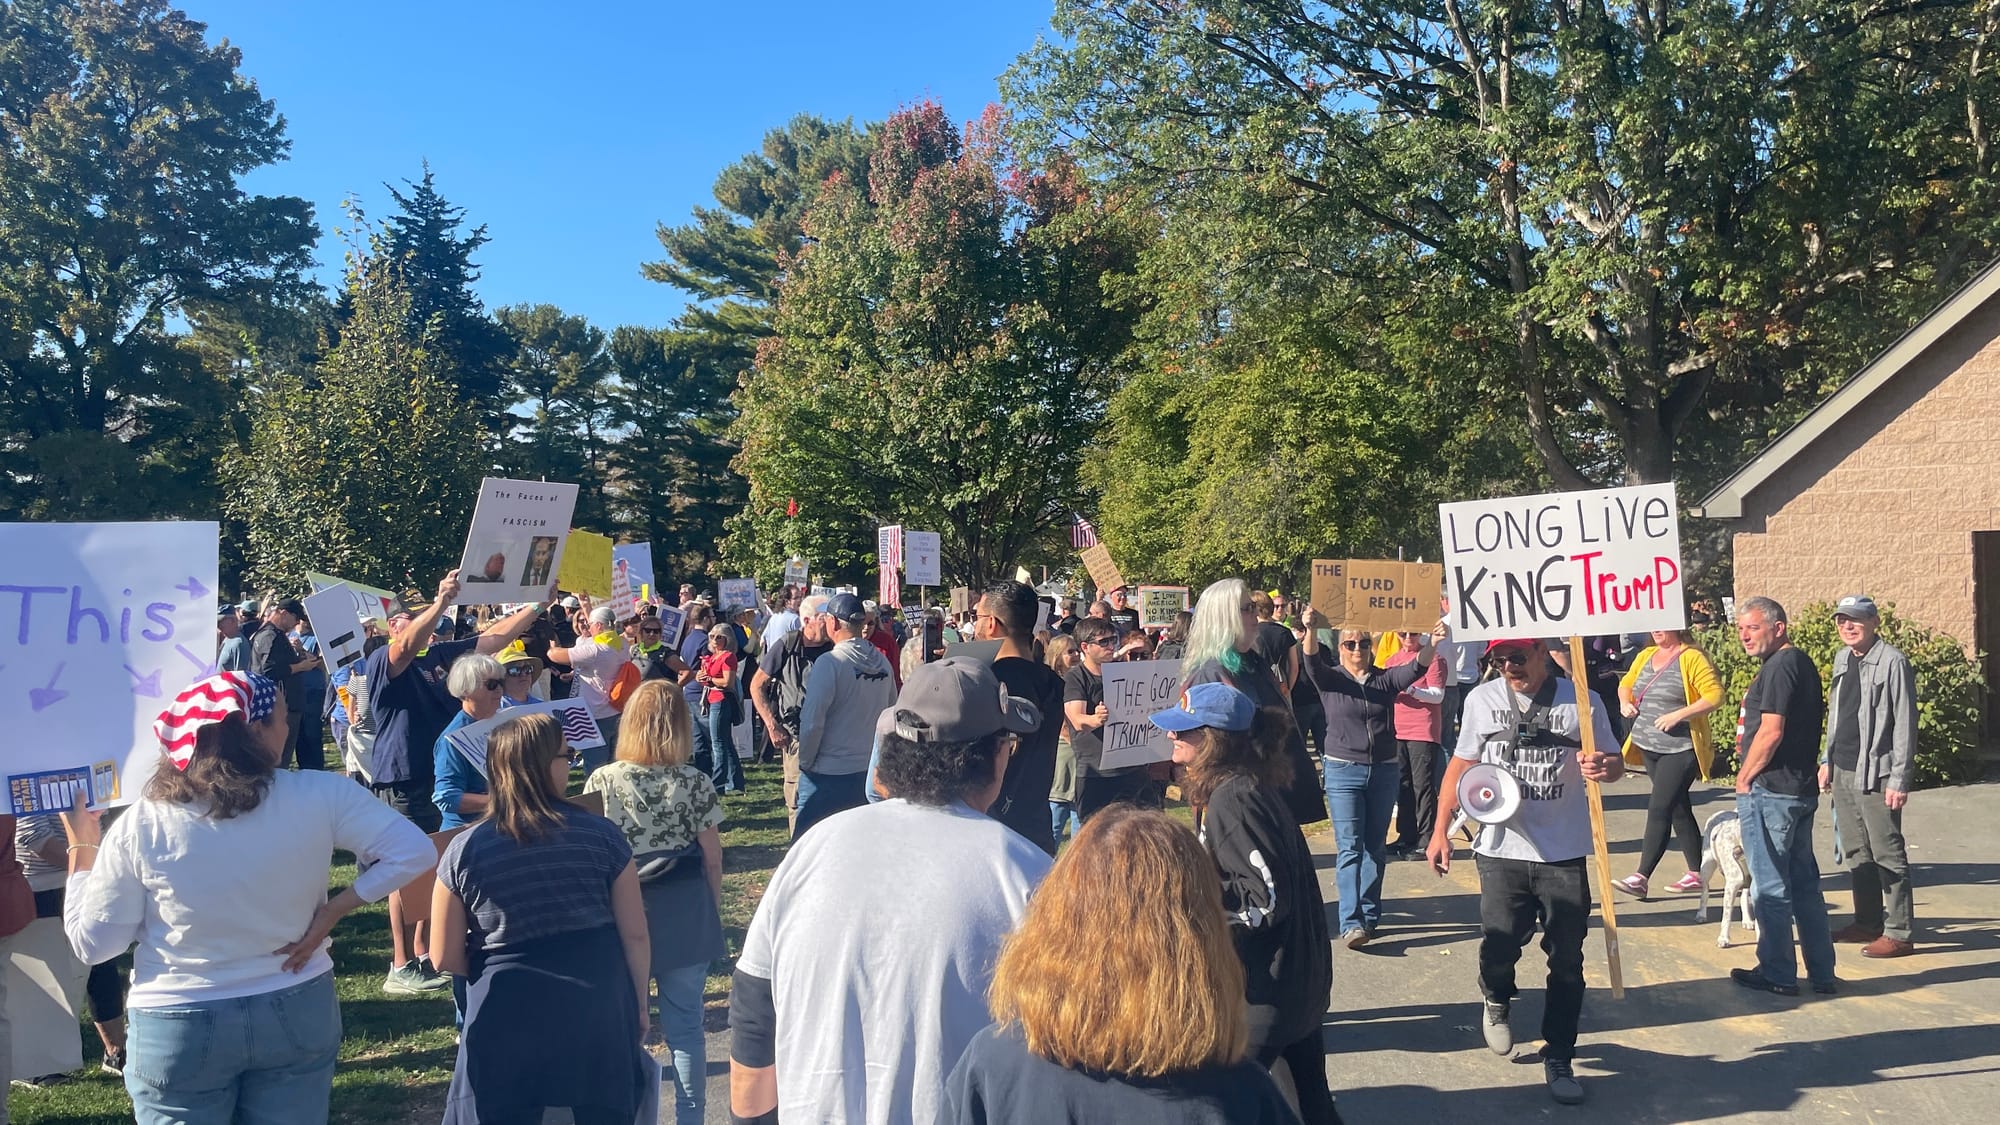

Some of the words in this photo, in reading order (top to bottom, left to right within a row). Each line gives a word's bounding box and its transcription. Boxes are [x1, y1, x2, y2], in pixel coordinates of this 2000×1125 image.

[518, 492, 543, 501] Faces
[503, 517, 546, 527] FASCISM
[1449, 505, 1563, 554] LONG
[1315, 564, 1342, 577] THE
[1349, 577, 1395, 591] TURD
[1369, 596, 1416, 610] REICH
[0, 584, 176, 645] This
[1112, 678, 1144, 709] THE
[1150, 673, 1177, 701] GOP
[1108, 720, 1156, 749] TRUMP
[11, 779, 21, 798] YES
[20, 778, 32, 812] RETAIN
[1519, 783, 1565, 801] OCKET
